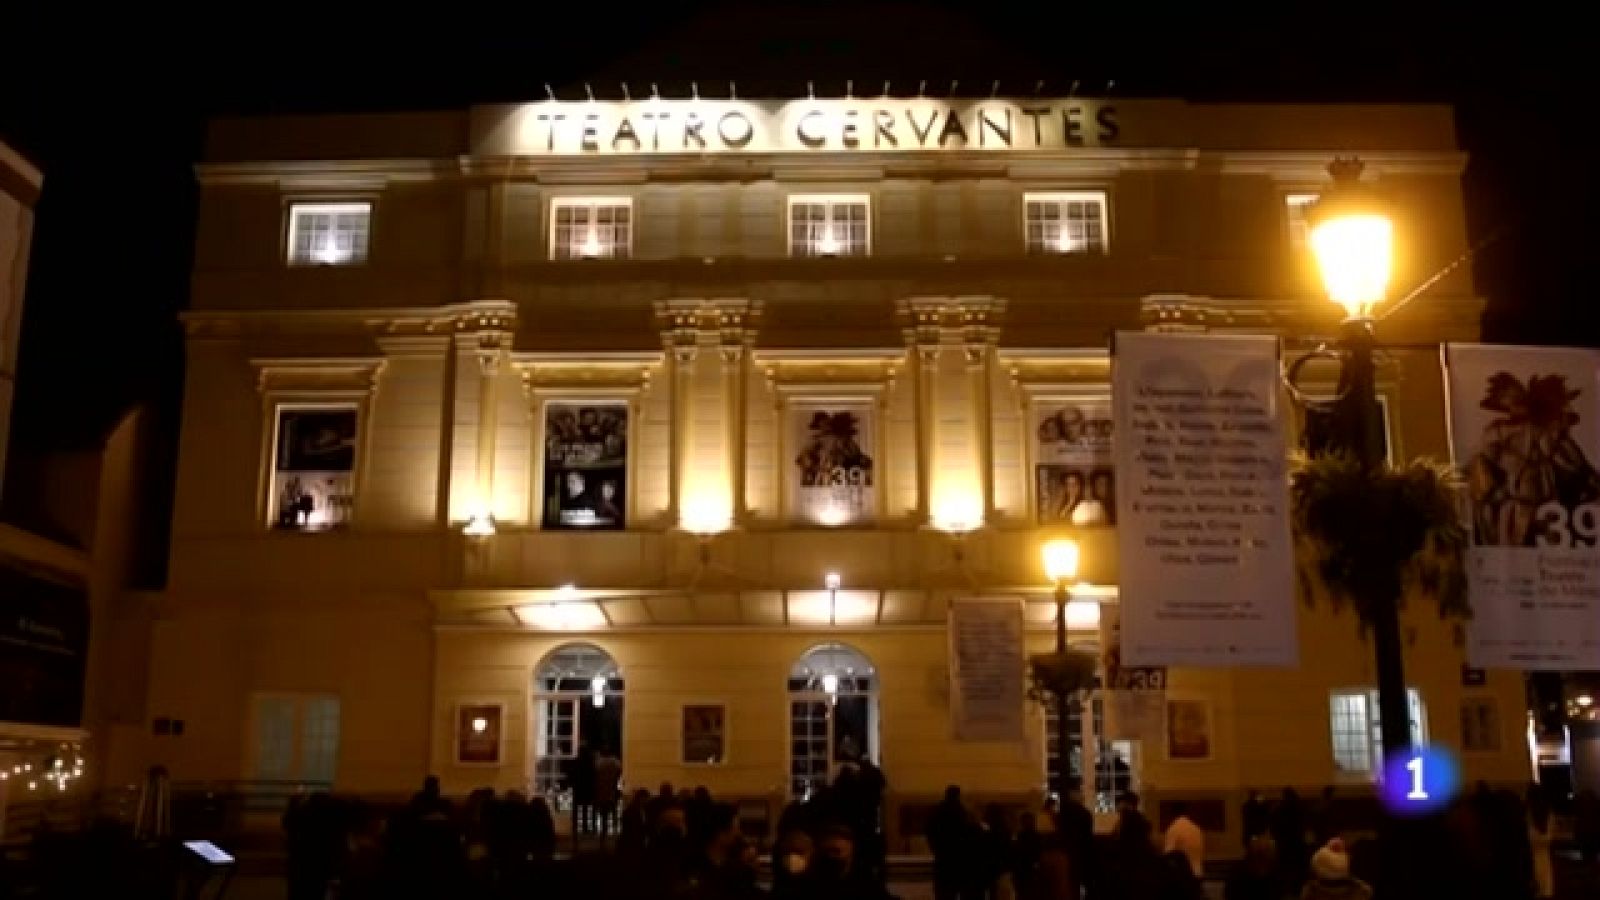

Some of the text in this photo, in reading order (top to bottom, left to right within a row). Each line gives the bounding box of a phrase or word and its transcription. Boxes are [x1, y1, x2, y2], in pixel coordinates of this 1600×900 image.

[537, 107, 1121, 151] TEATRO CERVANTES
[1535, 502, 1600, 550] 39
